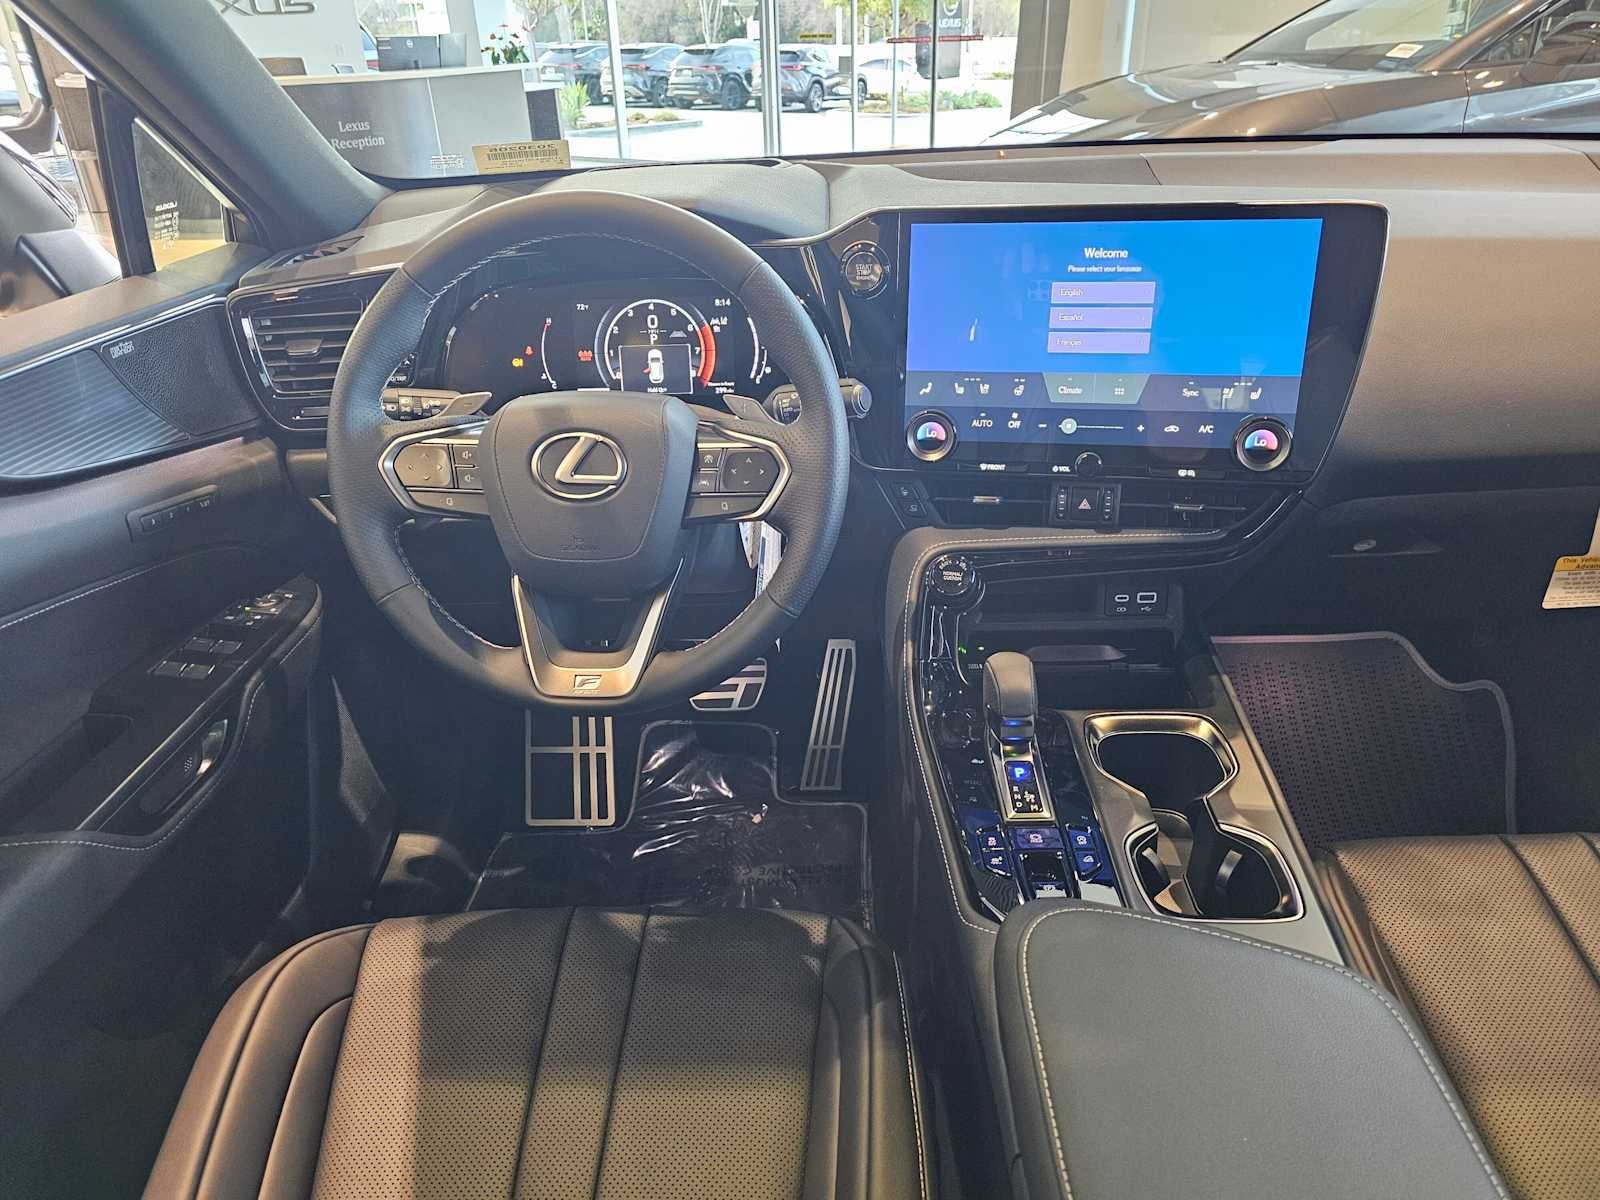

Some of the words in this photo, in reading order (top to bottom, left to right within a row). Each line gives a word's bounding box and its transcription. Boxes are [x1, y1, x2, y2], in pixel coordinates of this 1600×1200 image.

[338, 120, 370, 133] Lexus
[331, 135, 385, 150] Reception
[1084, 247, 1129, 258] Welcome
[714, 298, 731, 306] 8:14
[628, 309, 634, 317] 3
[612, 326, 619, 334] 2
[649, 333, 658, 345] P
[694, 347, 700, 355] 7
[1058, 386, 1083, 395] Climate
[1182, 388, 1200, 397] Sync
[971, 419, 993, 428] AUTO
[1008, 420, 1021, 429] Off
[926, 428, 937, 438] Lo
[1198, 424, 1214, 433] A/C
[1254, 436, 1268, 447] Lo
[1014, 767, 1025, 778] P
